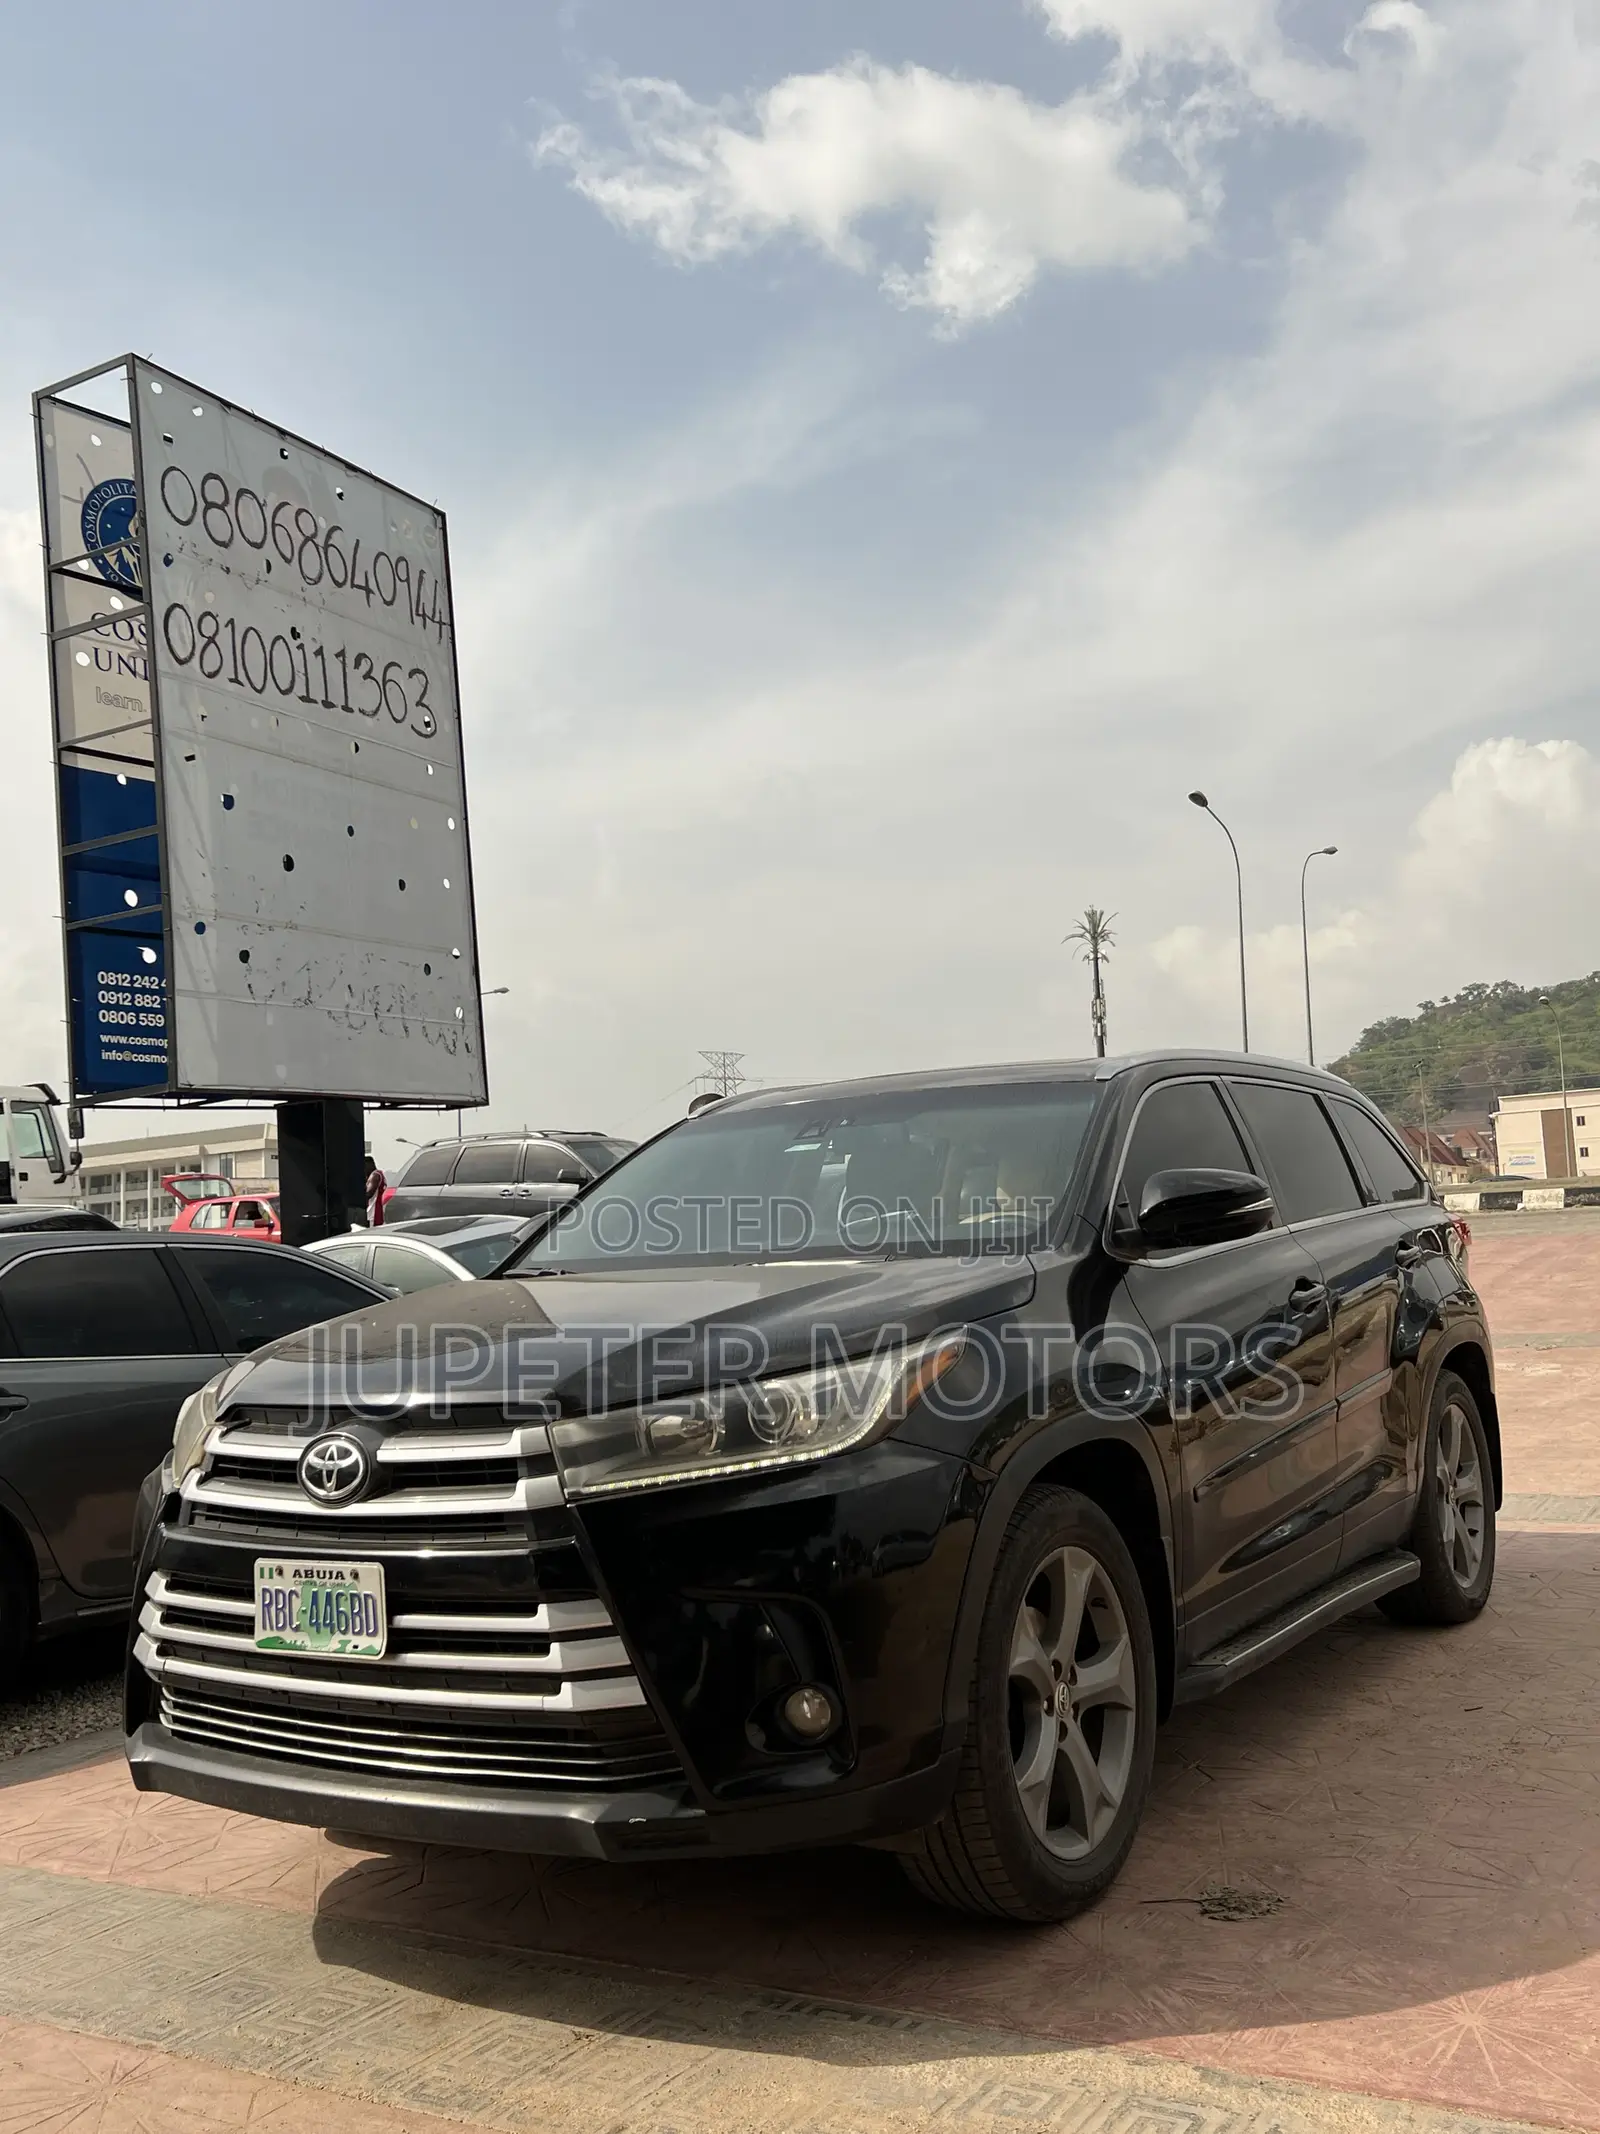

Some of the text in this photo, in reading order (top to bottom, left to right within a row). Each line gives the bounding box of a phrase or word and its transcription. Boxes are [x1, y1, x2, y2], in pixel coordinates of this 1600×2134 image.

[161, 466, 451, 643] 08068640944
[163, 602, 437, 738] 08100111363
[97, 971, 131, 987] 0812
[133, 975, 159, 989] 242
[98, 990, 161, 1008] 0912 882
[98, 1009, 165, 1027] 0806 559
[292, 1568, 345, 1580] ABUJA
[261, 1587, 378, 1637] RBC-446BD
